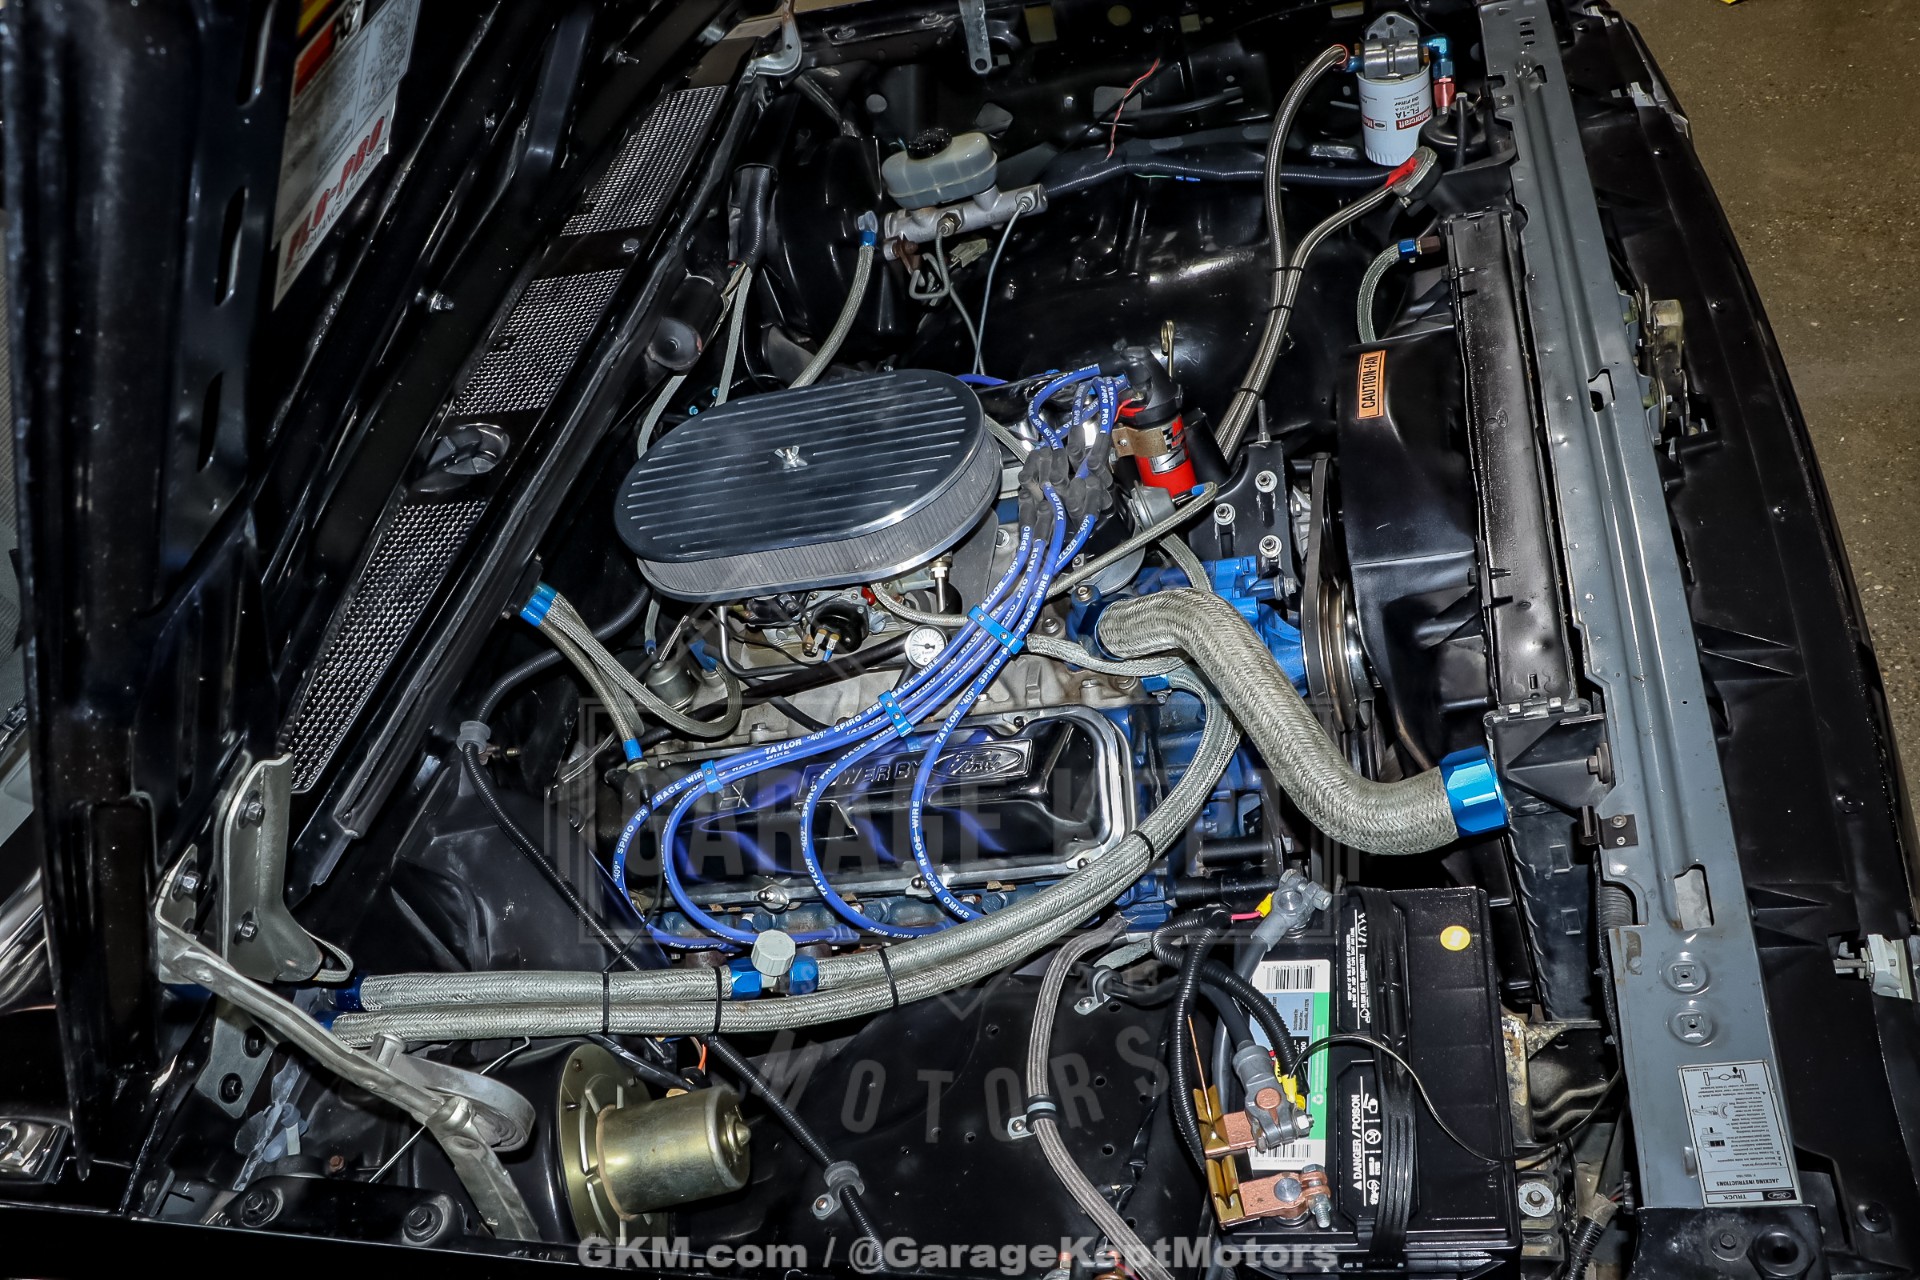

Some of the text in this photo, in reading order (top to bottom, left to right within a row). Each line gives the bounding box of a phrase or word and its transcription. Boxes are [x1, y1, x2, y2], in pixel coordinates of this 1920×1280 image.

[1395, 107, 1420, 119] FL-1A
[1101, 409, 1109, 425] PRO
[1050, 492, 1064, 521] TAYLOR
[981, 525, 1031, 611] AYLOR "409" SPIRO
[1017, 578, 1029, 599] PRO
[1027, 547, 1039, 573] RACE
[1019, 573, 1050, 633] RACE WIRE
[764, 738, 802, 755] TAYLOR
[806, 730, 827, 742] "409"
[833, 715, 862, 733] SPIRO
[891, 678, 915, 698] RACE
[918, 658, 940, 678] WIRE
[934, 709, 961, 744] TAYLOR
[960, 687, 975, 706] "409"
[977, 658, 1001, 685] SPIRO
[841, 743, 867, 760] RACE
[871, 726, 895, 741] WIRE
[819, 762, 837, 780] PRO
[802, 784, 818, 818] SPIRO
[612, 860, 622, 882] "409"
[617, 824, 635, 855] SPIRO
[634, 808, 648, 822] PR
[655, 782, 682, 803] RACE
[685, 771, 704, 784] WIR
[805, 858, 828, 897] TAYLOR
[911, 800, 970, 919] SPIRO PRO RACE WIRE
[867, 926, 889, 936] WIRE
[1350, 1094, 1362, 1130] POISON
[1352, 1138, 1362, 1180] DANGER
[1716, 1178, 1755, 1187] INSTRUCTIONS
